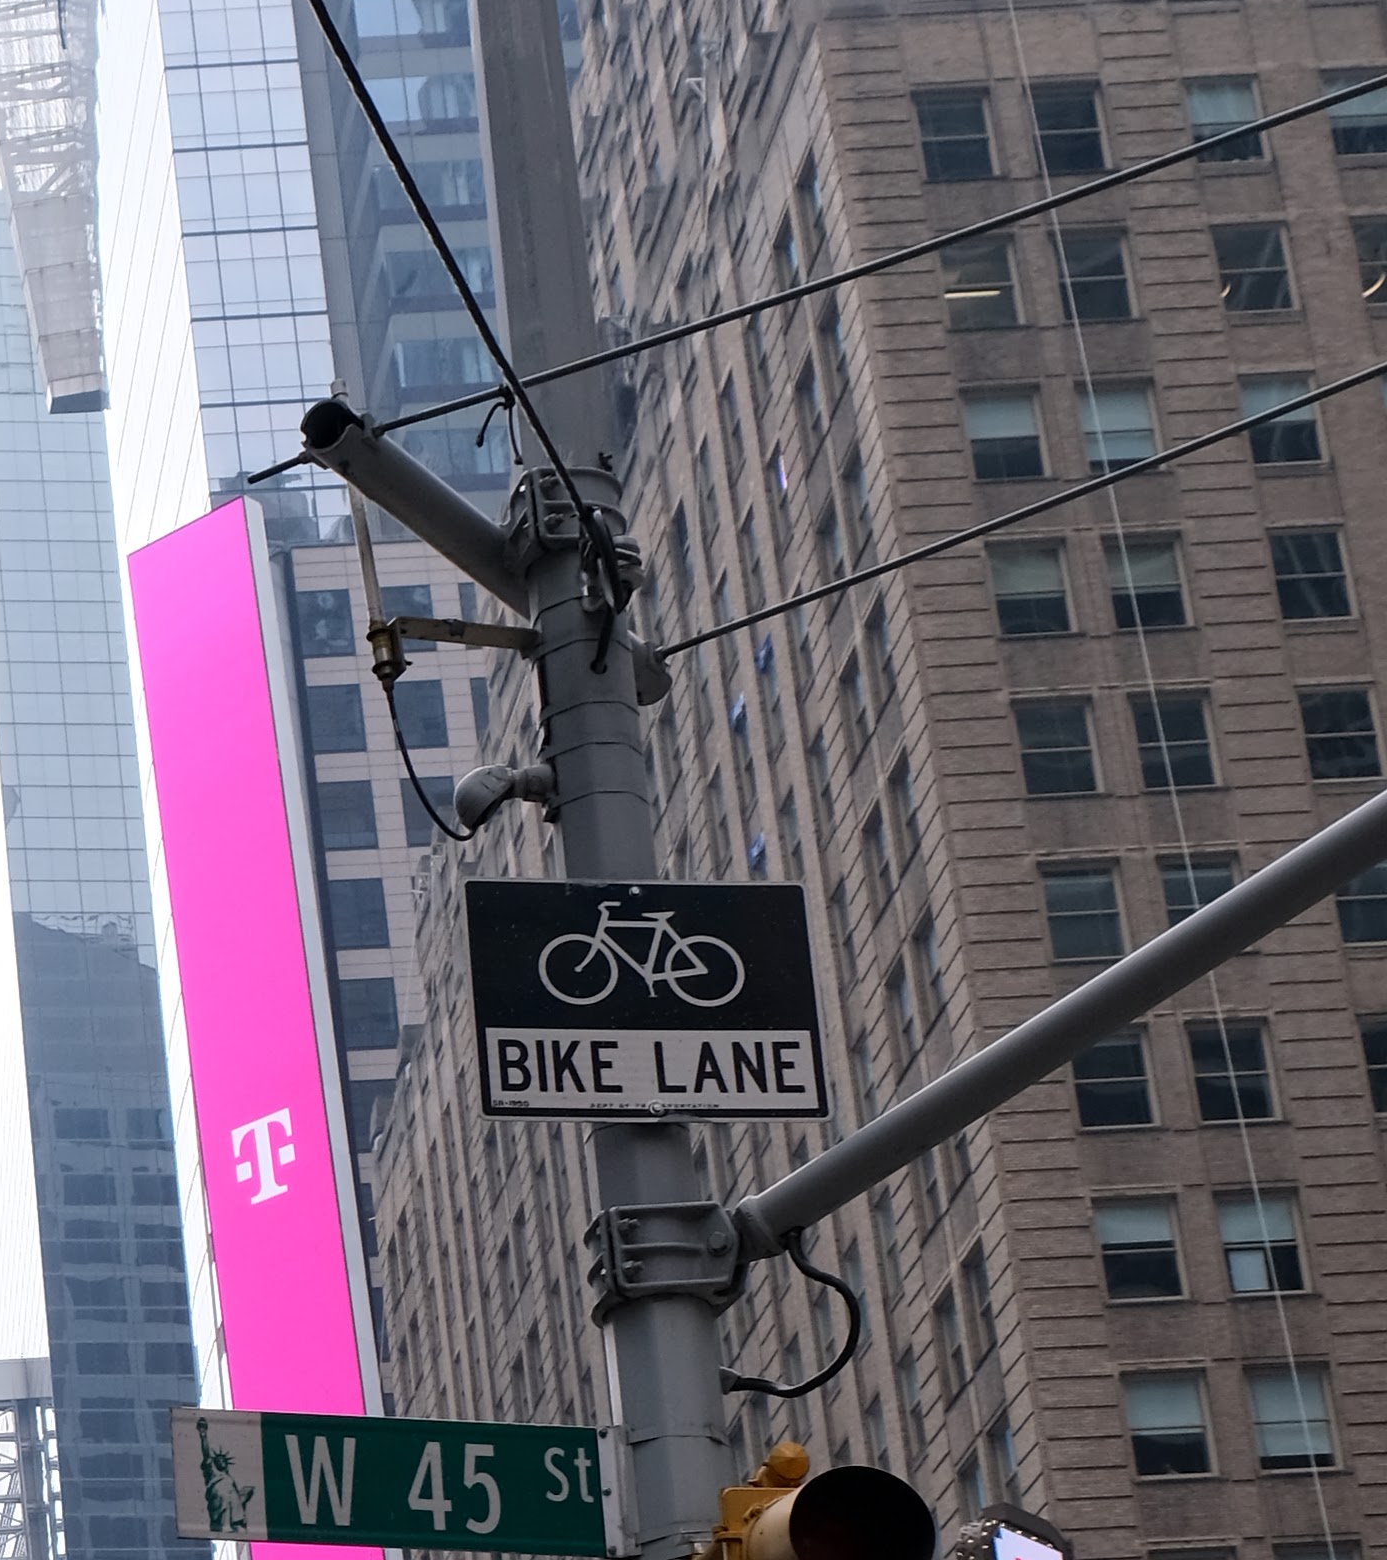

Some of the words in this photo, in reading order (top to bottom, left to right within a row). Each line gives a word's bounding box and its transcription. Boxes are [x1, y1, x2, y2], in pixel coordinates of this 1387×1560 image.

[497, 1038, 624, 1093] BIKE
[654, 1041, 806, 1094] LANE
[284, 1433, 356, 1527] W
[407, 1441, 502, 1535] 45
[544, 1446, 595, 1504] St
